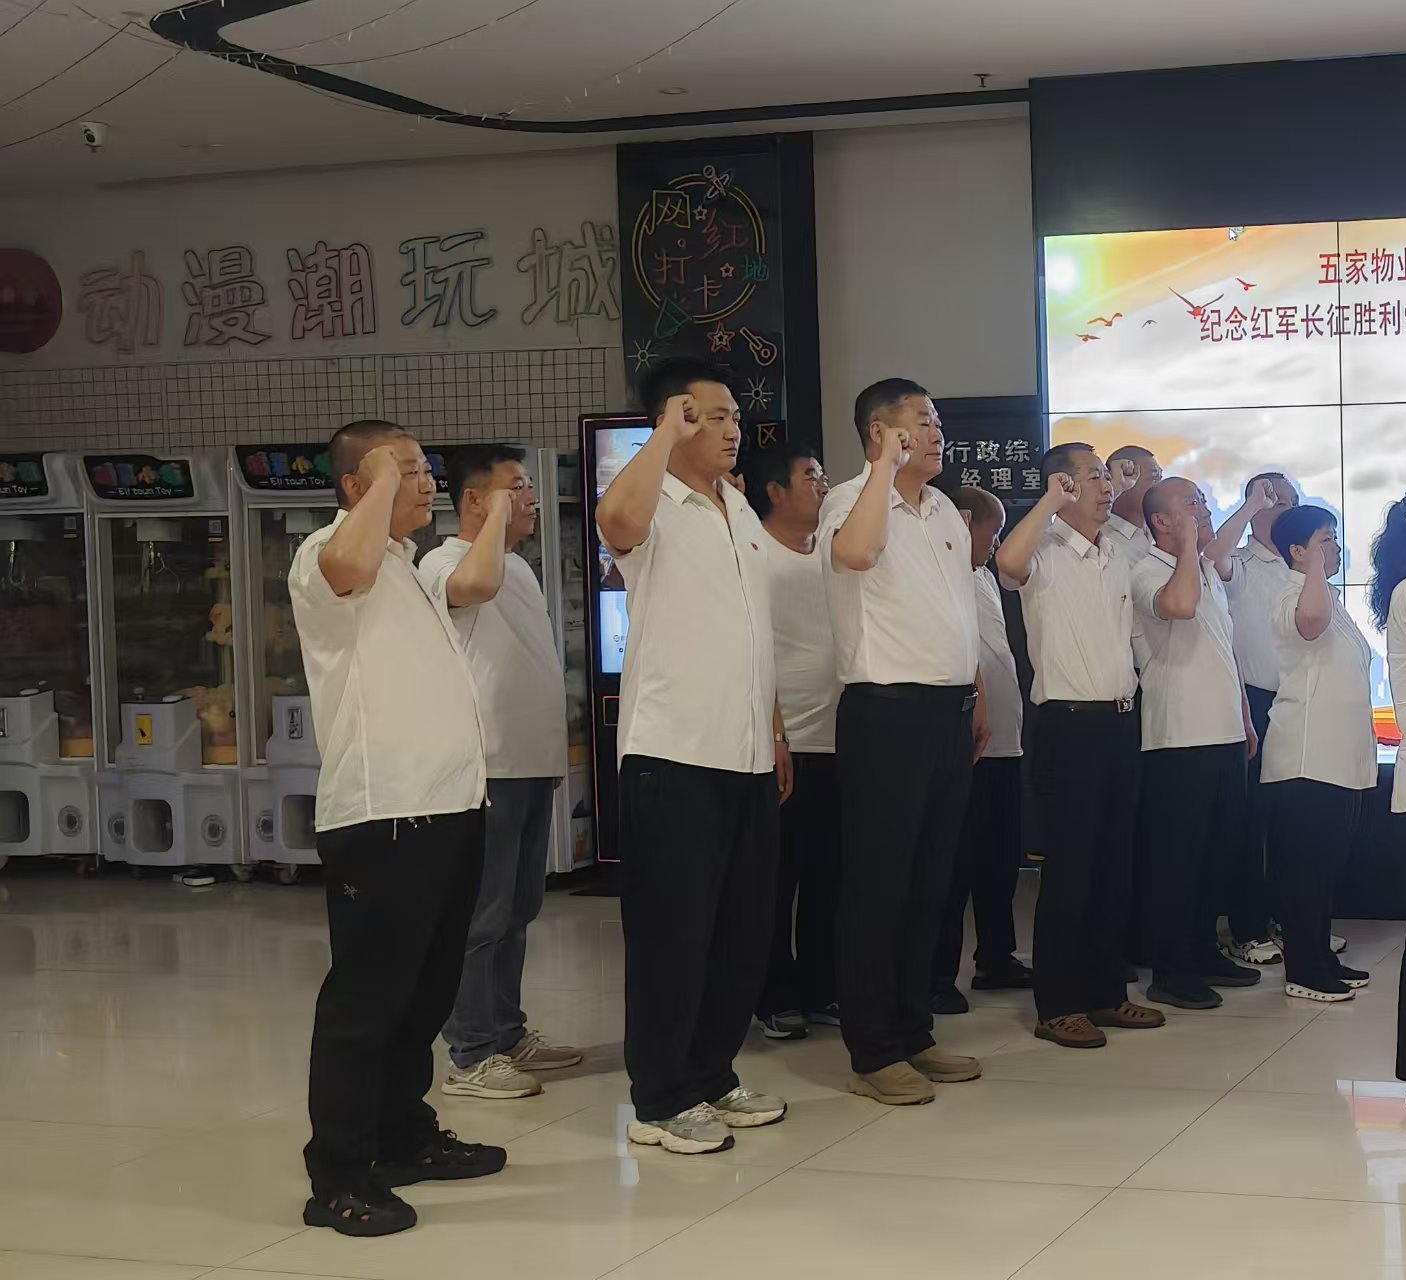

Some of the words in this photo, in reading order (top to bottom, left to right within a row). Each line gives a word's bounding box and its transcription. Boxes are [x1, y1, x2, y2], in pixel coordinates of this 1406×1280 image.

[78, 220, 621, 355] 动漫潮玩城
[945, 439, 1039, 464] 行政综
[960, 467, 1041, 490] 经理室
